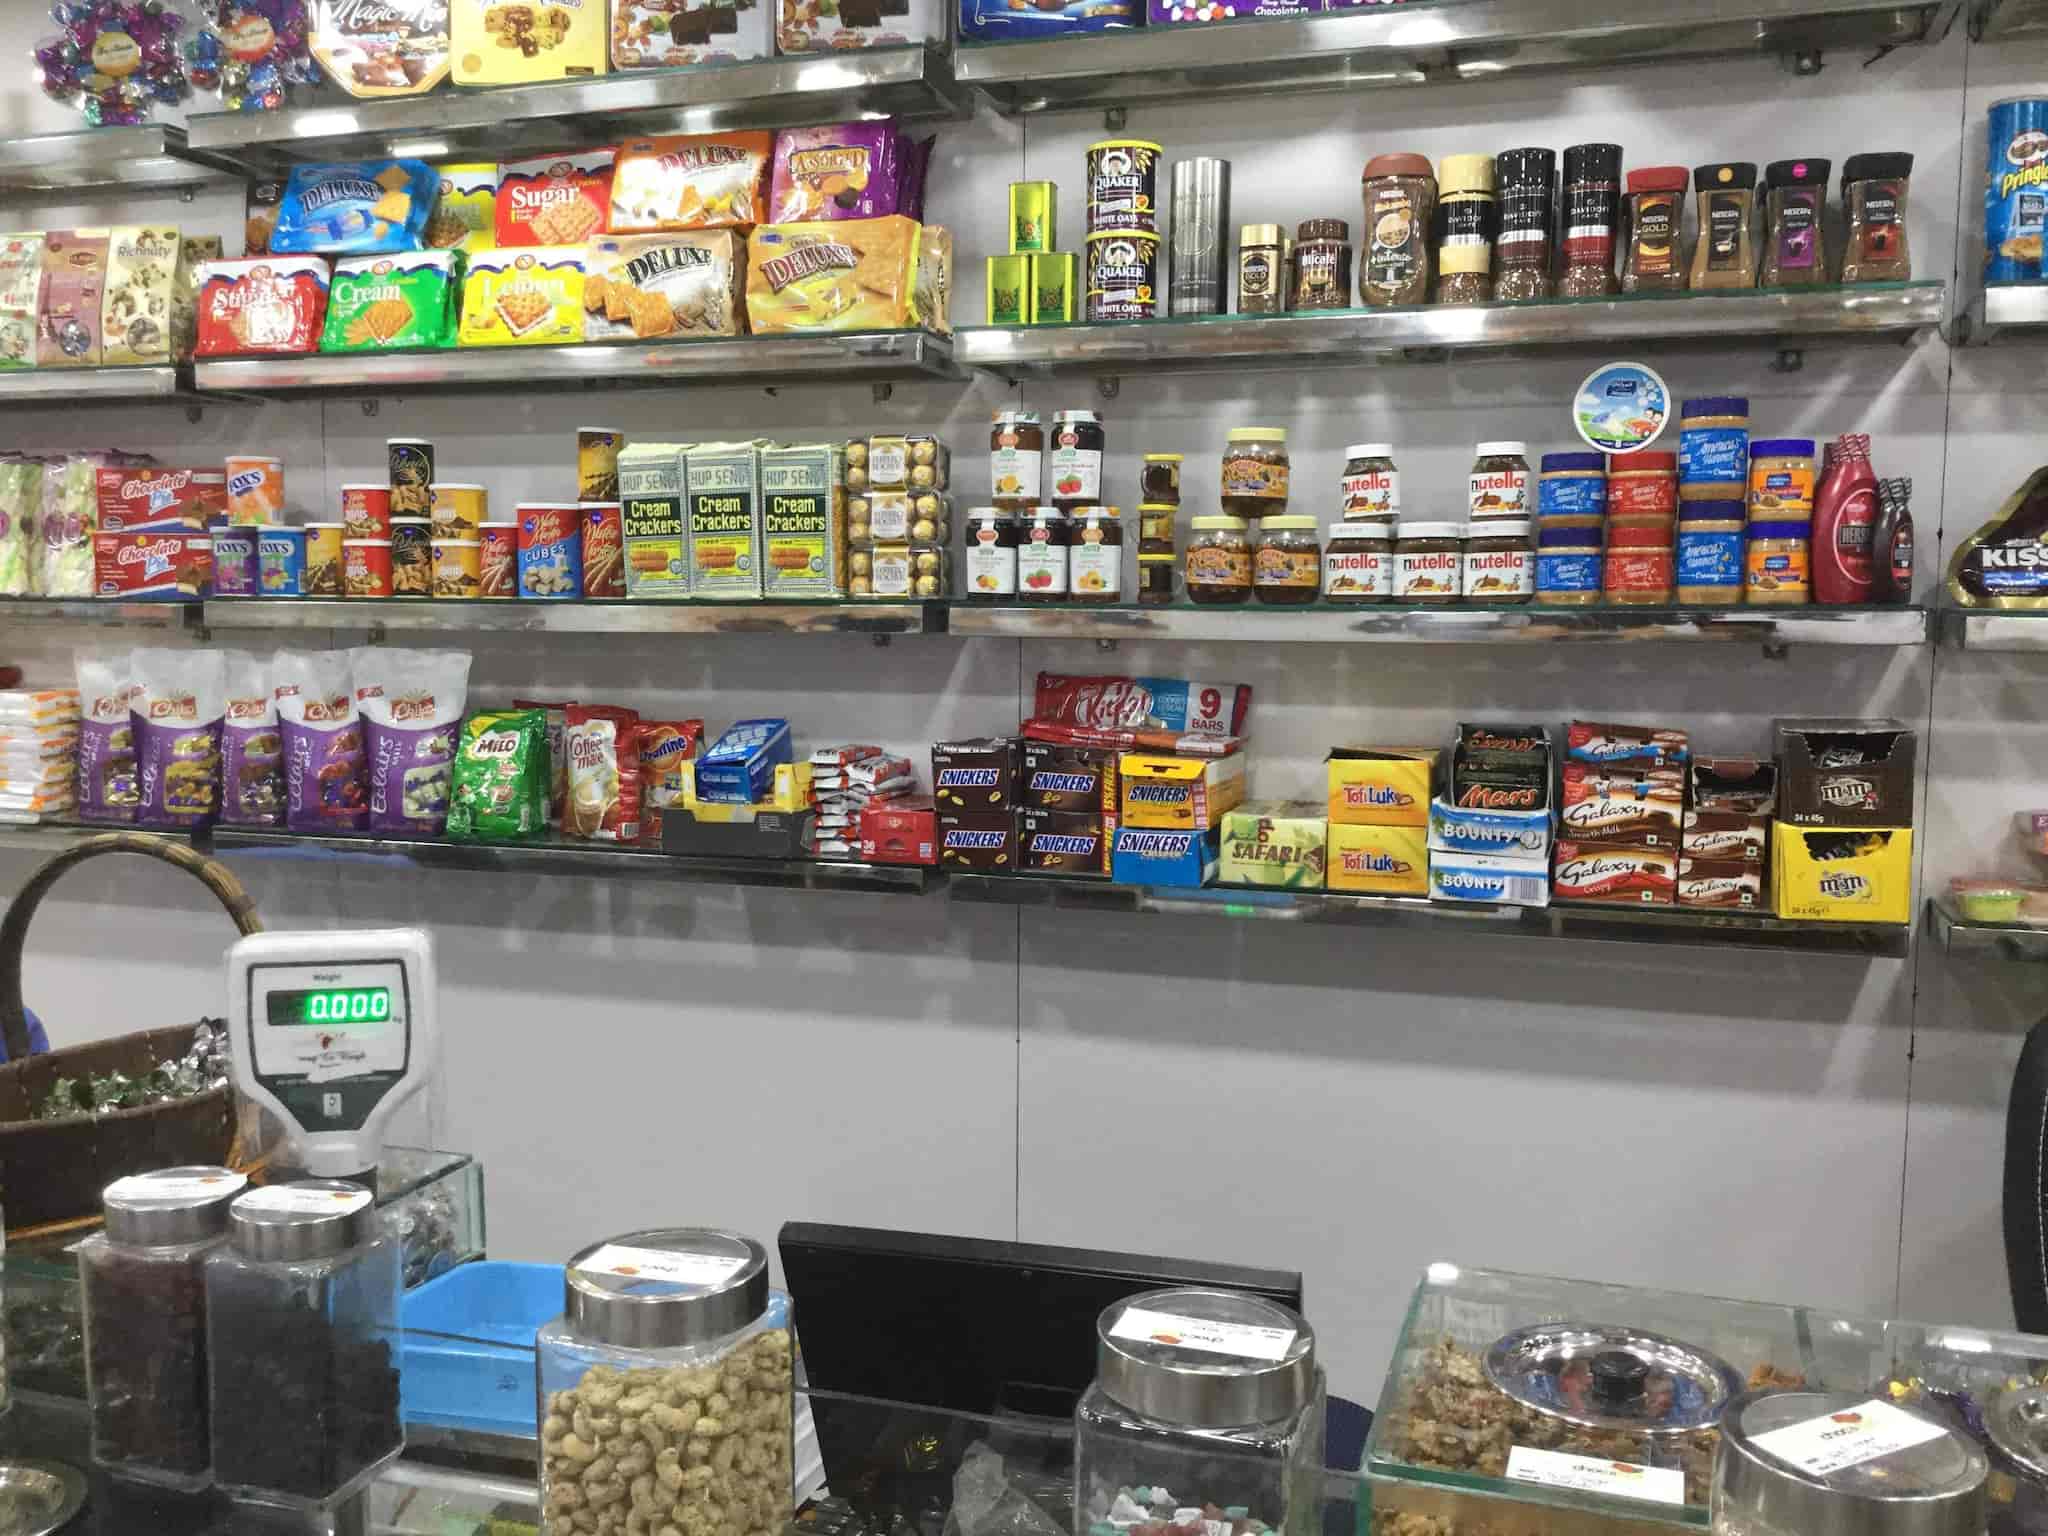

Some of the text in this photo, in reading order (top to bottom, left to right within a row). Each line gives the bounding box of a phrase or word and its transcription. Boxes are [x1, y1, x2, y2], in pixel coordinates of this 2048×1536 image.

[1096, 175, 1140, 190] QUAKER
[511, 185, 580, 210] Sugar
[1641, 223, 1669, 233] GOLD
[626, 247, 713, 286] DELUXE
[762, 245, 858, 290] DELUXE
[1097, 265, 1144, 279] QUAKER
[334, 283, 401, 305] Cream
[1119, 303, 1142, 313] OATS
[121, 471, 188, 499] Chocolate
[1342, 472, 1390, 491] nutella
[1471, 471, 1525, 490] nutella
[631, 501, 670, 518] Cream
[699, 496, 741, 513] Cream
[773, 496, 816, 513] Cream
[625, 519, 681, 536] Crackers
[692, 514, 750, 532] Crackers
[767, 514, 825, 532] Crackers
[117, 541, 181, 565] Chocolate
[525, 544, 566, 561] CUBES
[1329, 554, 1379, 569] nutella
[1470, 552, 1523, 569] nutella
[1403, 554, 1456, 570] nutella
[1199, 688, 1222, 719] 9
[1191, 718, 1225, 731] BARS
[477, 736, 517, 753] MILO
[571, 732, 603, 757] Coffee
[370, 735, 395, 814] Eclairs
[940, 769, 998, 785] SNICKERS
[1031, 772, 1094, 792] SNICKERS
[1130, 785, 1189, 801] SNICKERS
[1458, 783, 1538, 809] Mars
[1565, 803, 1645, 825] Galaxy
[946, 831, 1004, 847] SNICKERS
[1443, 822, 1516, 843] BOUNTY
[1031, 835, 1095, 854] SNICKERS
[1119, 833, 1190, 852] SNICKERS
[1690, 835, 1744, 850] Galaxy
[1231, 844, 1301, 864] SAFARI
[1556, 859, 1637, 883] Galaxy
[1443, 874, 1504, 891] BOUNTY
[1686, 880, 1738, 897] Galaxy
